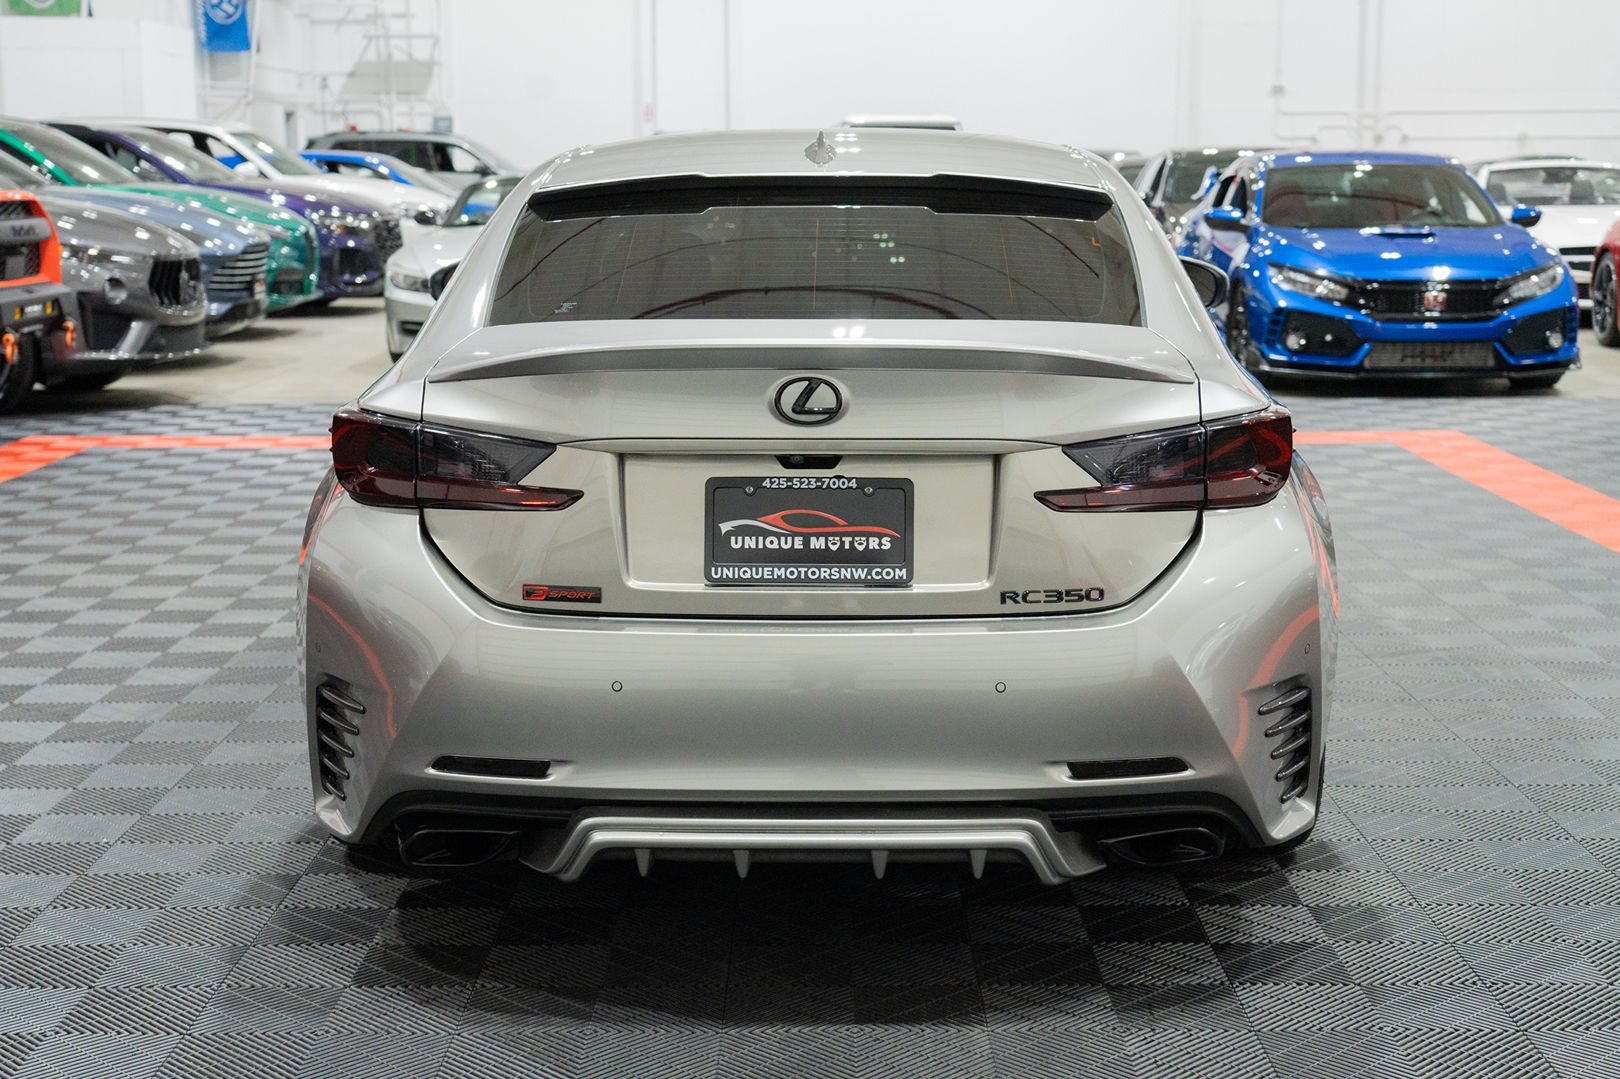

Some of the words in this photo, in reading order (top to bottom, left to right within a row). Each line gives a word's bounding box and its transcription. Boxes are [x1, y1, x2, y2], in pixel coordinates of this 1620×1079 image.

[762, 478, 857, 489] 425-523-7004
[730, 536, 804, 549] UNIQUE
[810, 536, 892, 552] MOTORS
[711, 567, 907, 580] UNIQUEMOTORSNW.COM
[549, 590, 595, 599] SPORT
[1000, 587, 1105, 605] RC350
